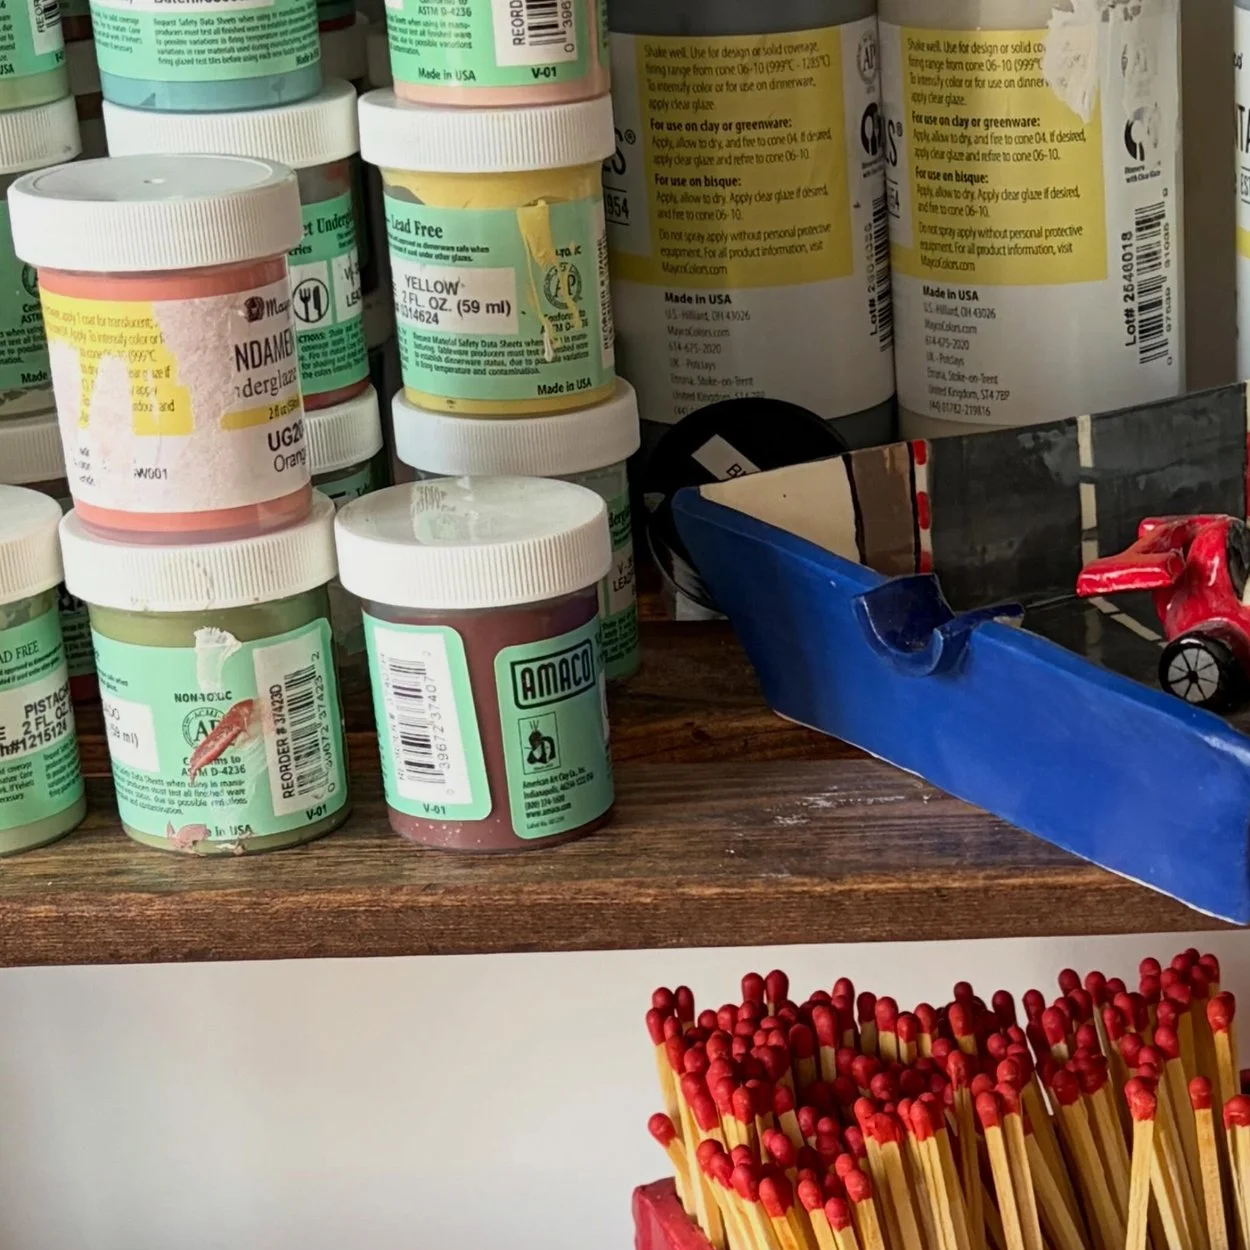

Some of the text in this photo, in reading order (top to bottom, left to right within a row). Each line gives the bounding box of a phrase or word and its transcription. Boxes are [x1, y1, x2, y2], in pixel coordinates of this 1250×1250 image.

[418, 67, 477, 81] Made in USA
[531, 66, 557, 80] V-01
[651, 118, 792, 135] For use on clay or greenware:
[924, 114, 939, 125] use
[939, 114, 951, 126] on
[951, 114, 969, 130] clay
[971, 117, 981, 127] or
[983, 117, 1041, 131] greenware:
[391, 214, 444, 239] Lead Free
[404, 274, 461, 296] YELLOW
[664, 292, 732, 305] Made in USA
[923, 286, 979, 302] Made in USA
[428, 296, 453, 312] OZ.
[457, 299, 481, 320] (59
[486, 299, 512, 317] ml)
[1123, 308, 1137, 348] Lot#
[537, 377, 592, 396] Made in USA
[16, 640, 40, 661] FREE
[521, 648, 591, 701] AMACO
[22, 721, 31, 736] 2
[211, 765, 246, 778] D-4236
[277, 737, 294, 800] REORDER
[306, 804, 328, 822] V-01
[423, 803, 447, 815] V-01
